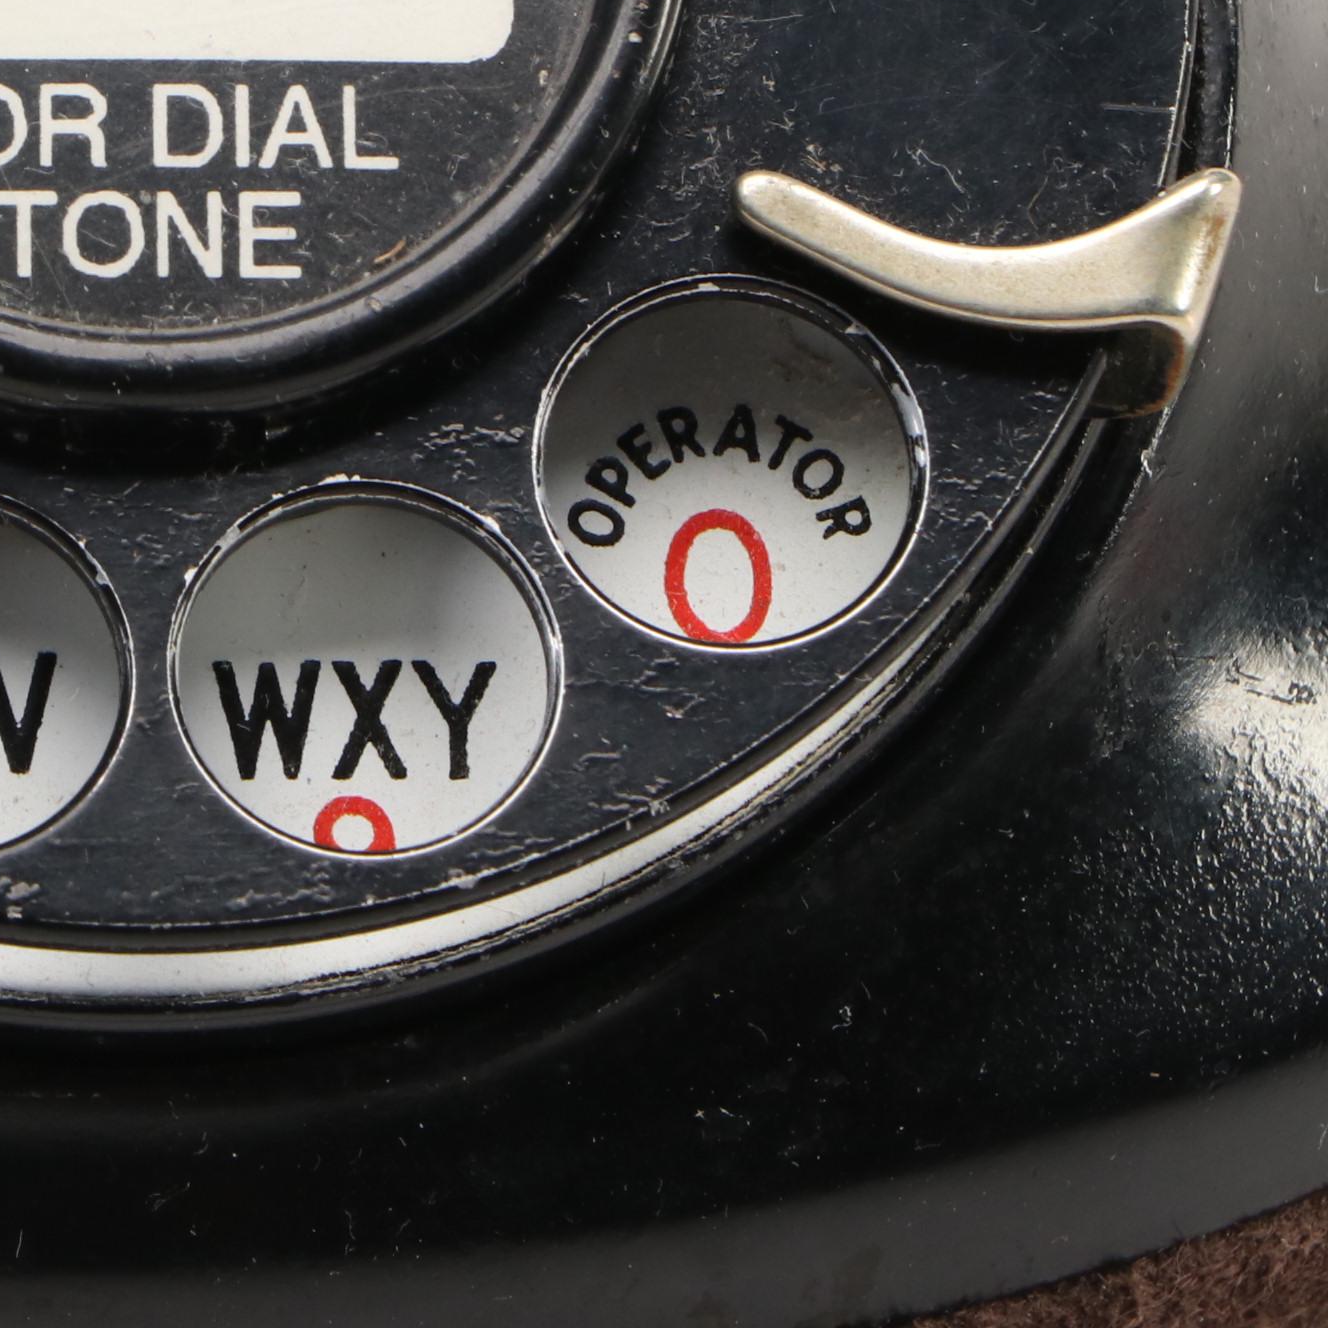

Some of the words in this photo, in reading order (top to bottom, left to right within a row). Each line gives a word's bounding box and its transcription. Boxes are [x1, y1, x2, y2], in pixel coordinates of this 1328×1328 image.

[153, 84, 399, 170] DIAL
[567, 404, 873, 547] OPERATOR
[663, 508, 774, 644] 0
[213, 659, 496, 781] WXY
